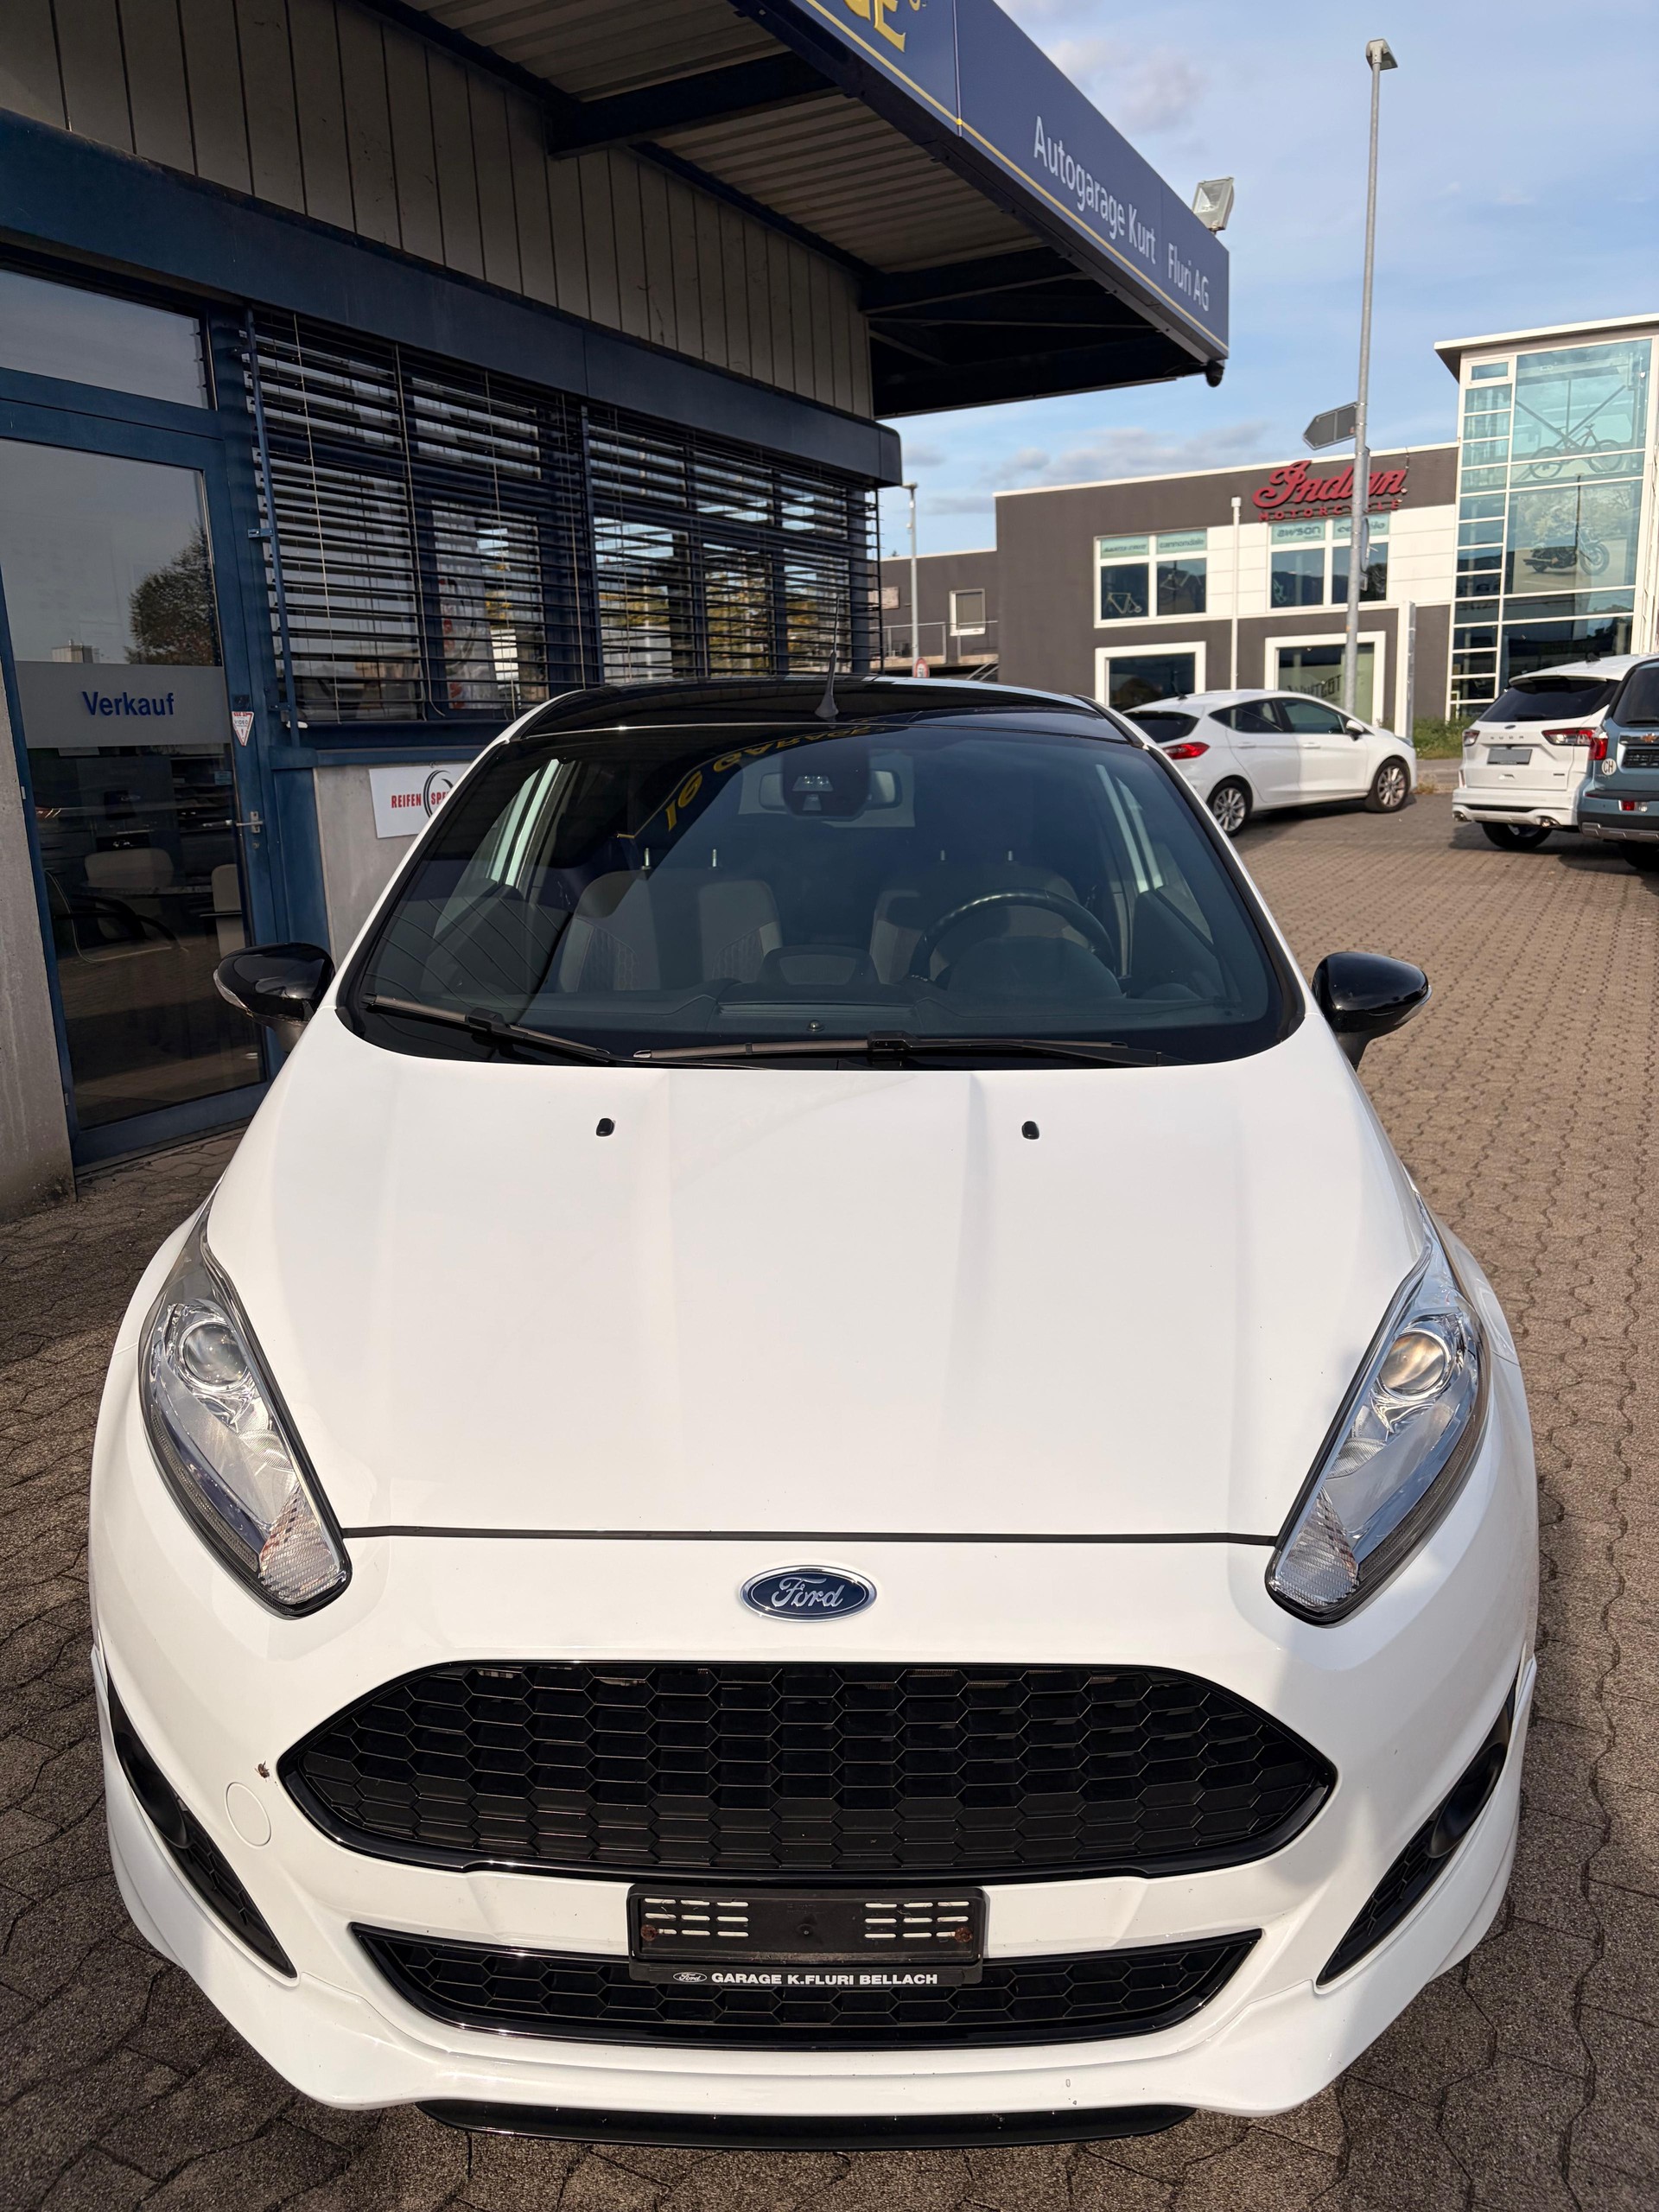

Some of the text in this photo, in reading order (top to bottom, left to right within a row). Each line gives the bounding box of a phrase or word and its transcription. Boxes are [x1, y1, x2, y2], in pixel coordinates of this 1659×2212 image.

[1034, 116, 1209, 311] Autogarage Kurt Fluri AG
[1258, 499, 1401, 522] MOTORCLE
[82, 691, 174, 715] Verkauf
[1603, 761, 1614, 772] CH
[391, 793, 422, 809] REIFEN
[771, 1577, 845, 1607] Ford
[678, 1973, 938, 1986] Ford GARAGE K.FLURI BELLACH
